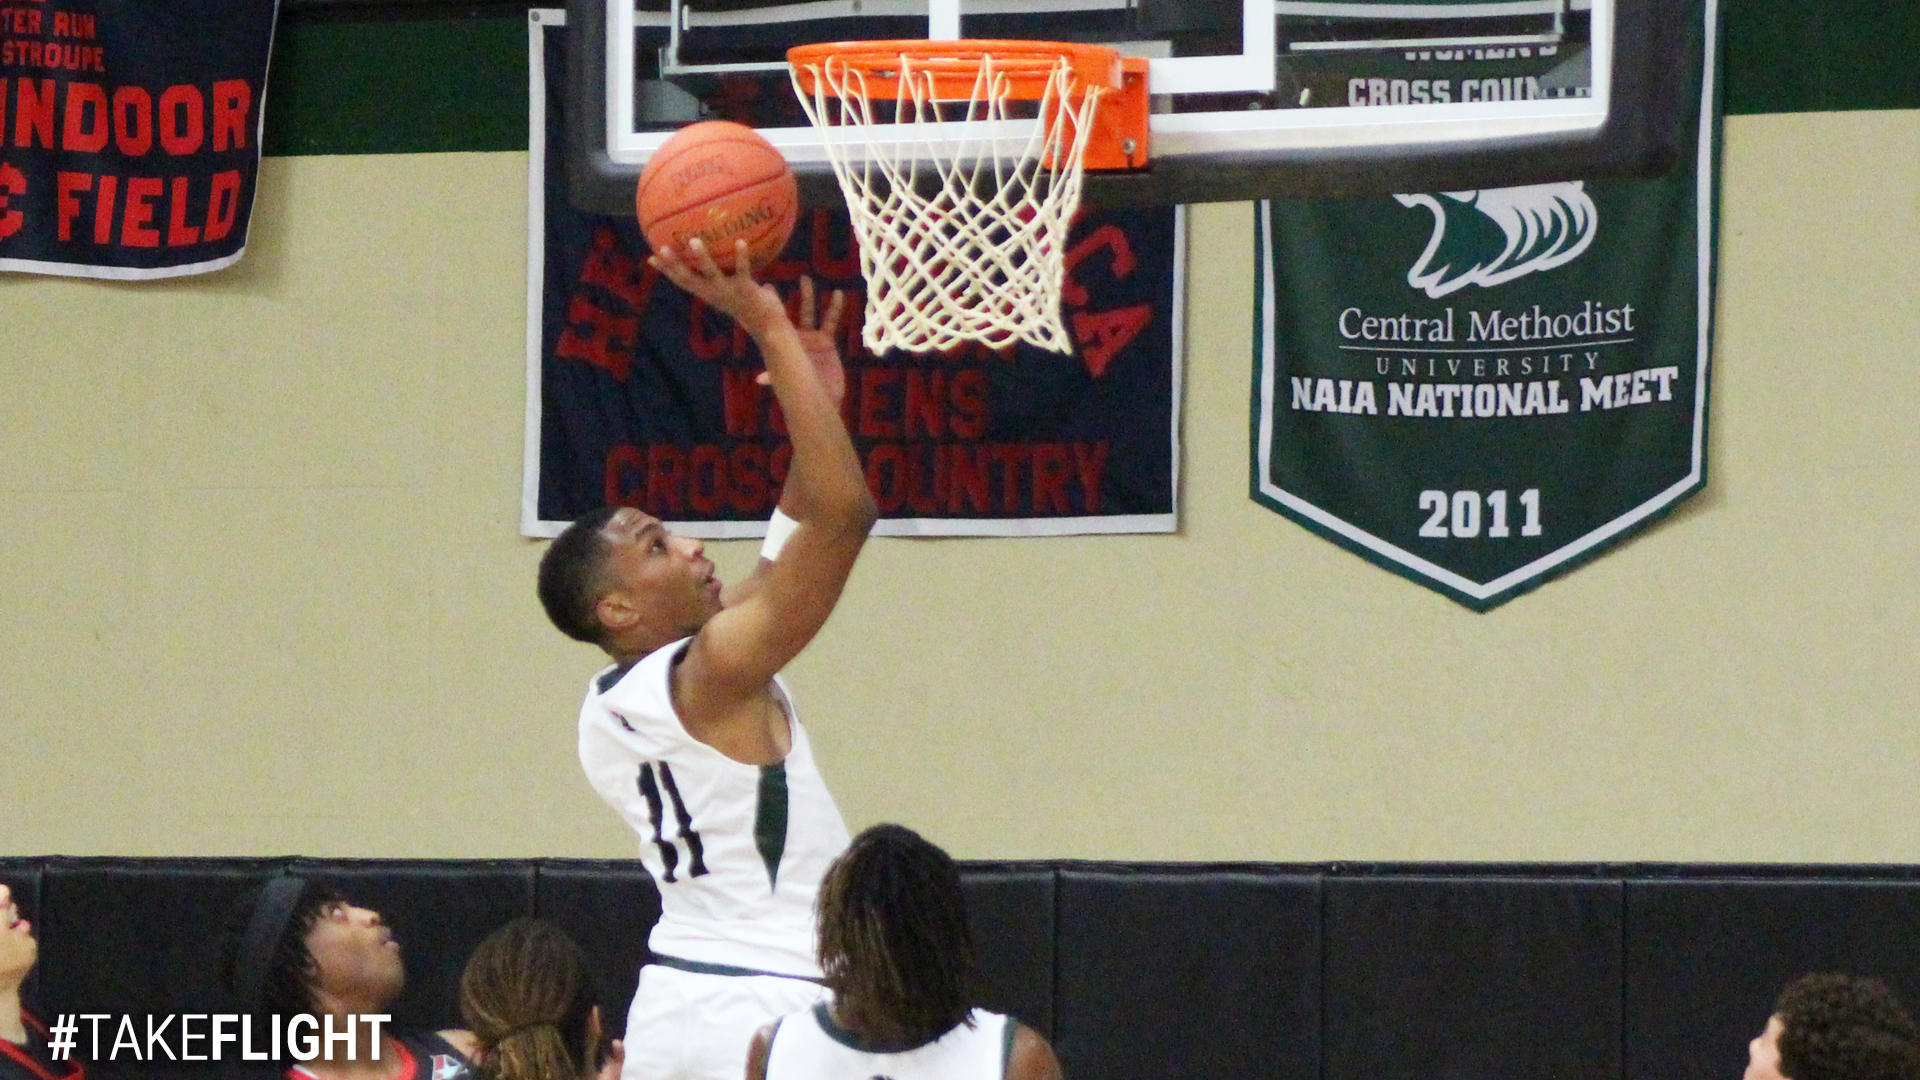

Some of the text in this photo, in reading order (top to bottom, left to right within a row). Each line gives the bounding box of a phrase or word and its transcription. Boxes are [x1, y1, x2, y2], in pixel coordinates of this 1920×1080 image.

[0, 8, 42, 34] TER
[1348, 76, 1542, 107] CROSS COUN
[57, 169, 242, 248] FIELD
[1338, 301, 1635, 343] Central Methodist
[1376, 352, 1600, 377] UNIVERSITY
[721, 367, 990, 438] WENS
[1291, 366, 1679, 418] NAIA NATIONAL MEET
[866, 438, 1112, 515] OUNTRY
[1418, 488, 1543, 539] 2011
[636, 759, 710, 884] 11
